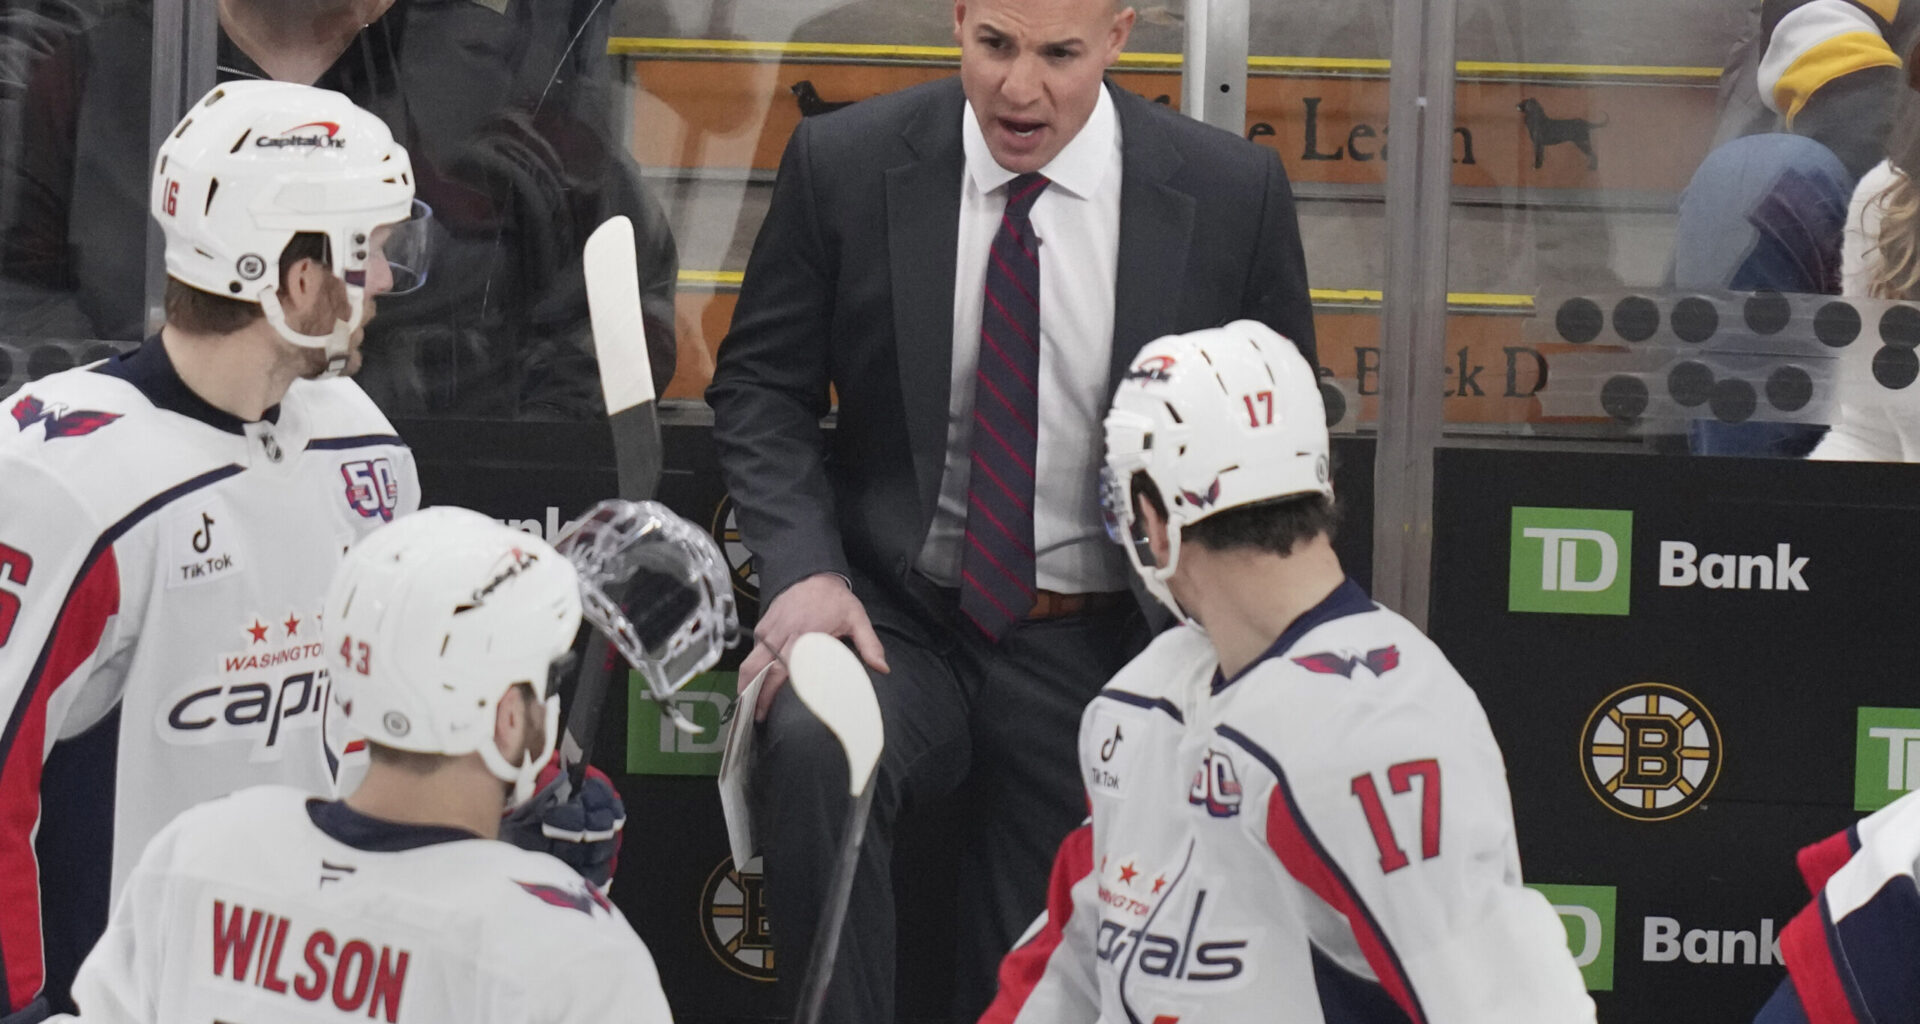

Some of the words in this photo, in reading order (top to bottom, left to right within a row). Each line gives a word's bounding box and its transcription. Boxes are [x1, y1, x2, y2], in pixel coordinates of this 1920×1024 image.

[162, 177, 180, 217] 16
[1243, 391, 1273, 427] 17
[341, 458, 397, 523] 50
[1523, 528, 1618, 592] TD
[1659, 540, 1810, 591] Bank
[225, 643, 325, 672] WASHINGTO
[340, 636, 371, 676] 43
[640, 690, 737, 753] TD
[1869, 727, 1920, 791] T
[1350, 758, 1441, 874] 17
[212, 899, 409, 1024] WILSON
[1643, 916, 1788, 966] Bank
